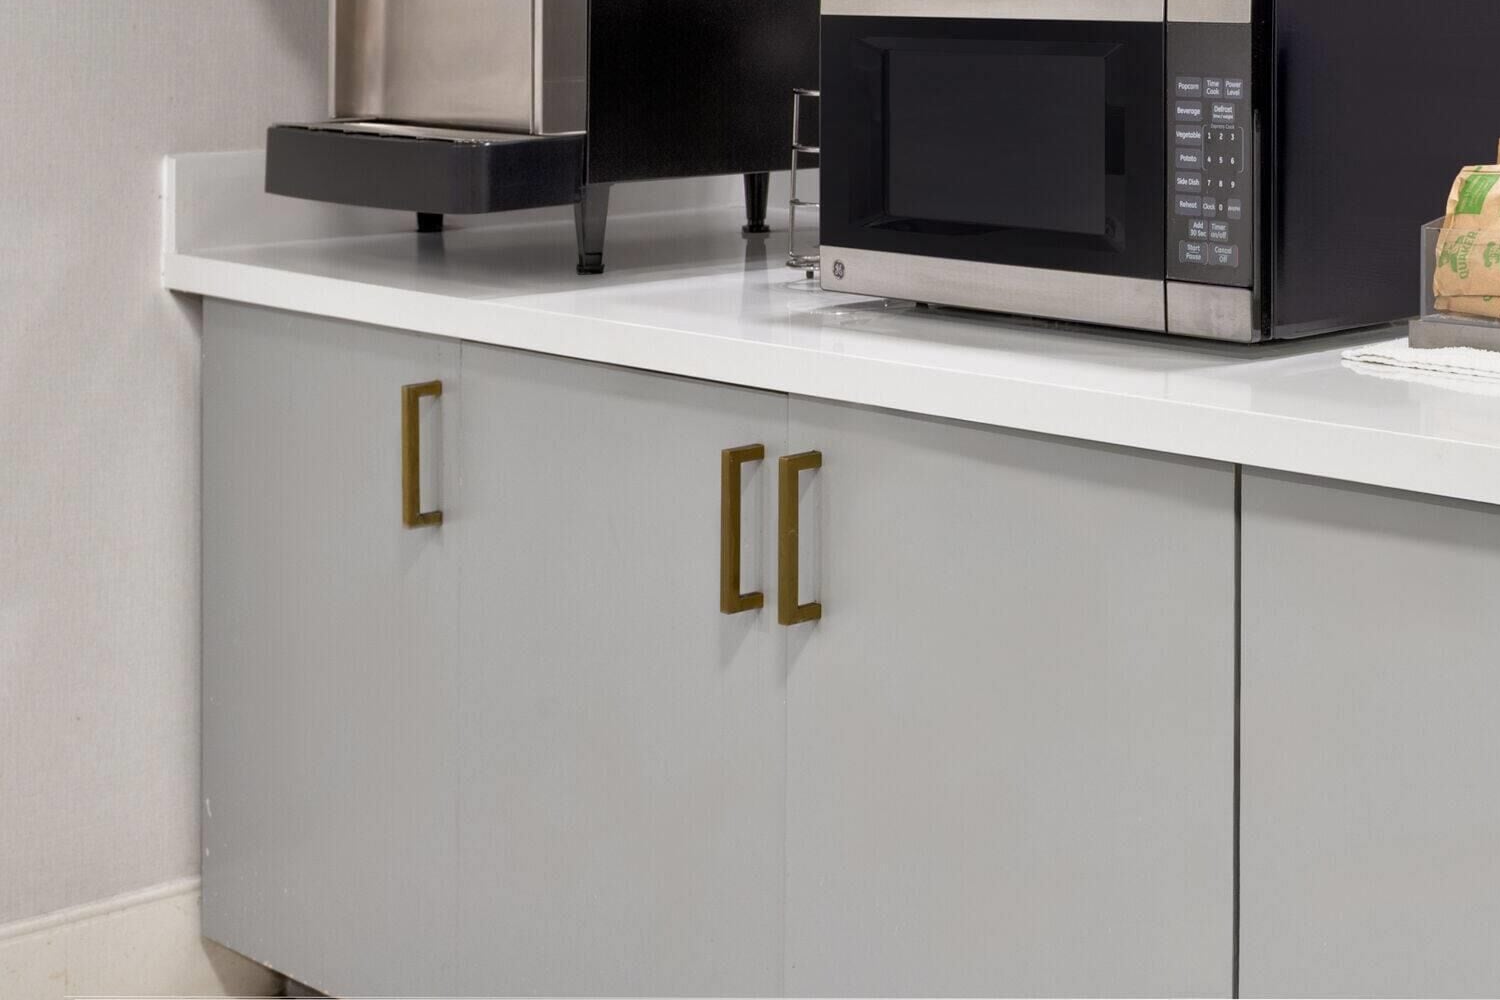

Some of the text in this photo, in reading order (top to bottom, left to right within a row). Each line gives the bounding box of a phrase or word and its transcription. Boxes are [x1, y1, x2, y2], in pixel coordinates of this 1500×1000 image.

[1178, 82, 1200, 91] Popcorn
[1206, 79, 1220, 88] Time
[1225, 80, 1242, 89] Power
[1176, 106, 1201, 117] Beverage
[1213, 105, 1233, 113] Defrost
[1175, 130, 1201, 140] Vegetable
[1179, 154, 1198, 162] Potato
[1176, 177, 1200, 186] Side Dish
[1179, 200, 1198, 209] Reheat
[1192, 221, 1204, 229] Add
[1211, 223, 1227, 231] Timer
[1186, 244, 1201, 252] Start
[1214, 246, 1232, 255] Cancel
[1185, 252, 1202, 260] Pause
[1458, 231, 1478, 279] QUAKER
